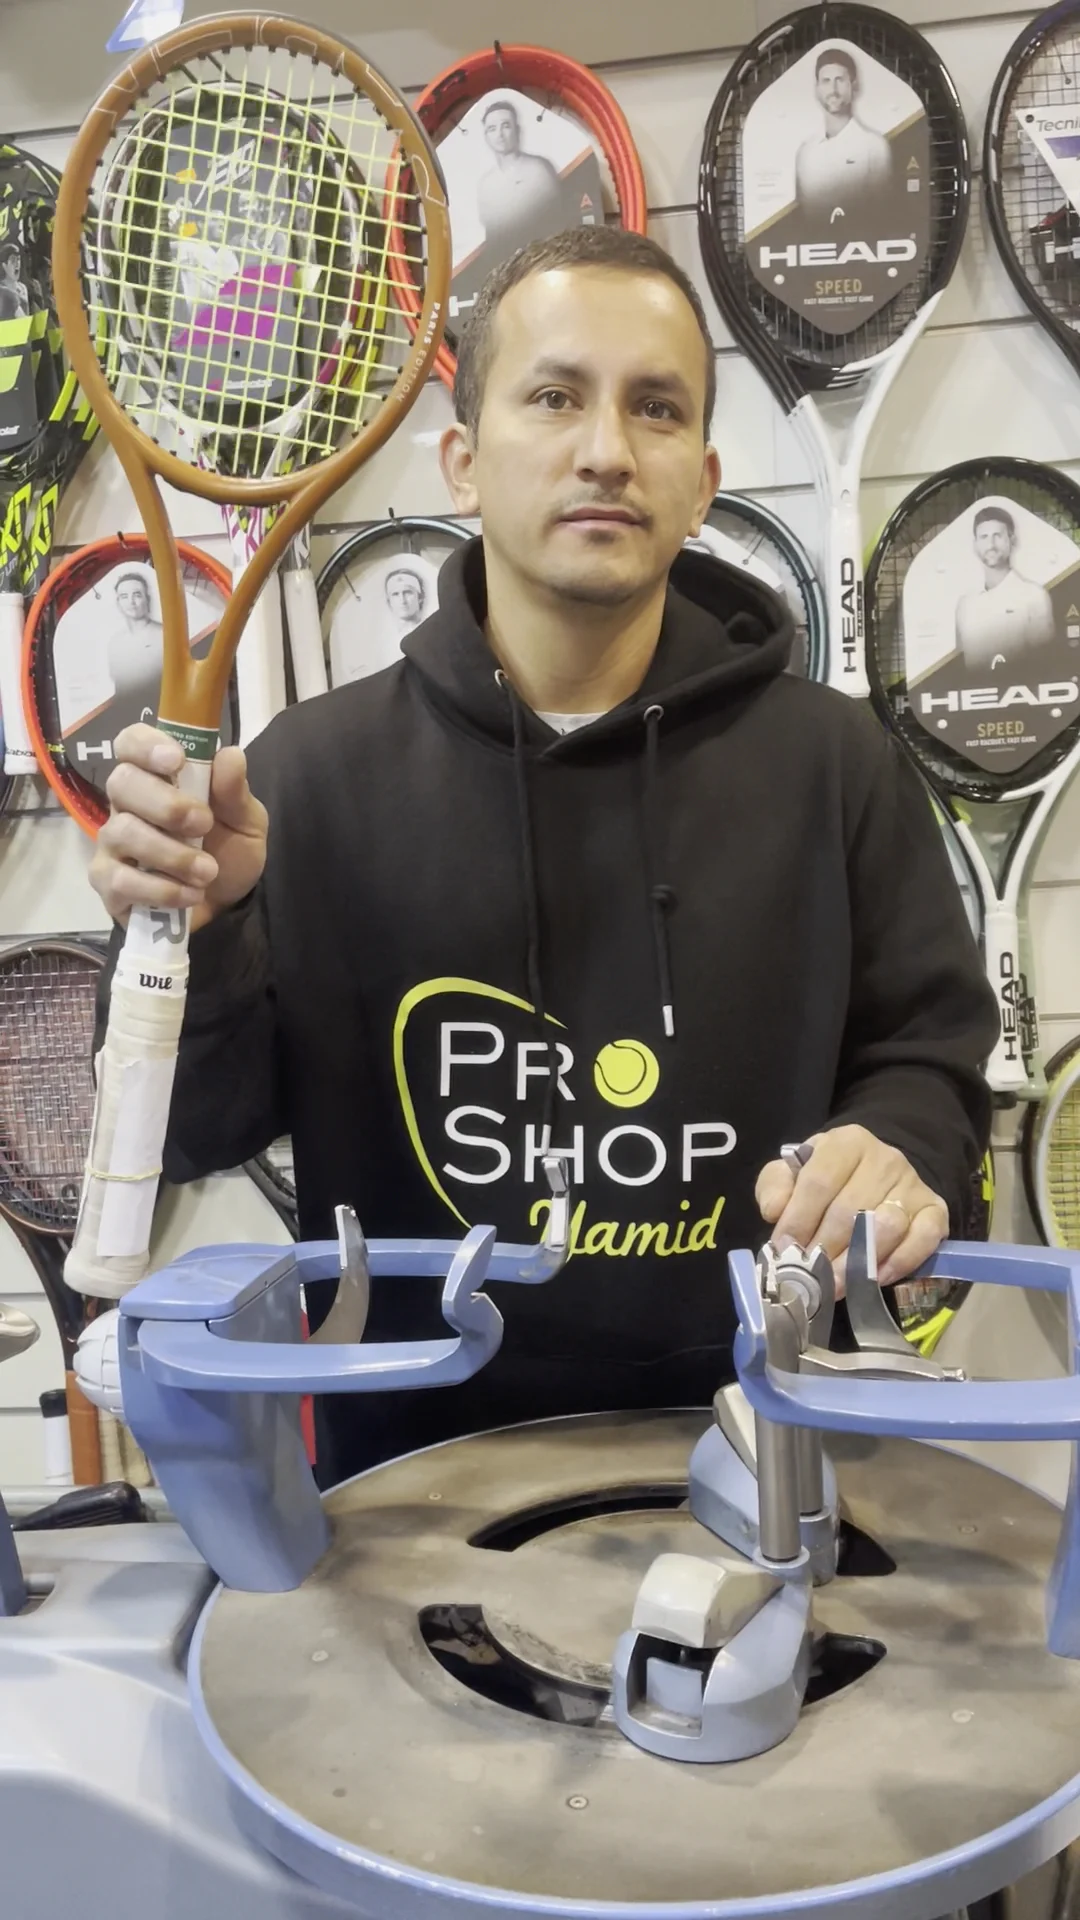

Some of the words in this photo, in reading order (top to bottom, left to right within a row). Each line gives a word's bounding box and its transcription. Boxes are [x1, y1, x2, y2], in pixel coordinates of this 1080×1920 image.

[1036, 116, 1080, 132] Tecni
[759, 238, 917, 268] HEAD
[815, 279, 862, 295] SPEED
[424, 302, 441, 344] PARIS
[396, 349, 427, 402] EDITION
[841, 557, 857, 673] HEAD
[920, 681, 1079, 714] HEAD
[977, 720, 1025, 738] SPEED
[1000, 951, 1017, 1061] HEAD
[442, 1105, 738, 1186] SHOP
